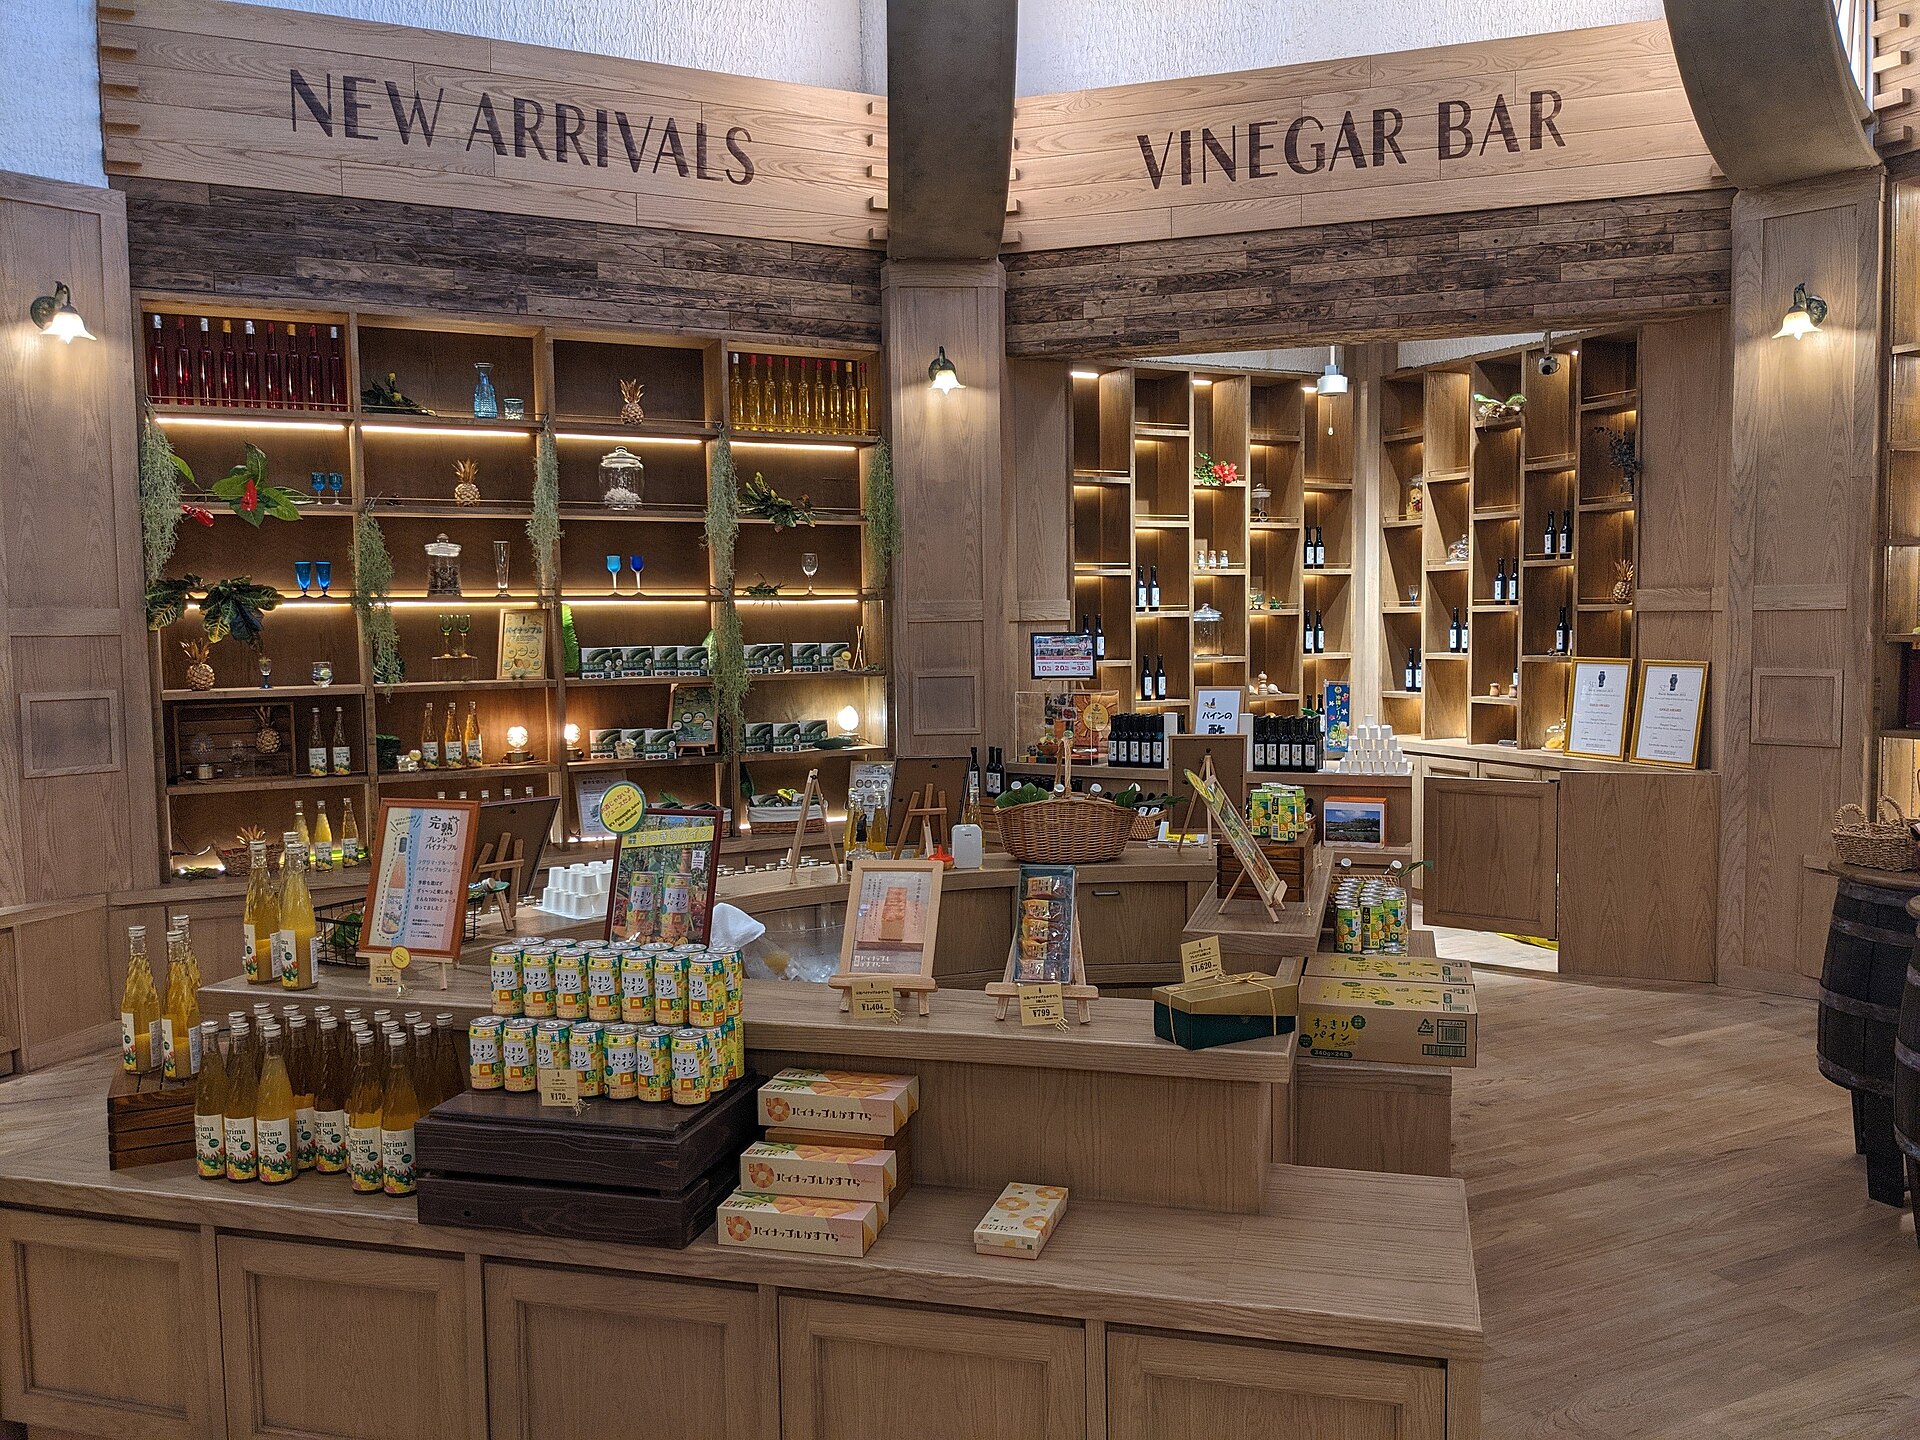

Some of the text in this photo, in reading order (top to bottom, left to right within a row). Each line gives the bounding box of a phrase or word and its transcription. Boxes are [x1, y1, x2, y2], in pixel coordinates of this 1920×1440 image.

[291, 69, 754, 186] NEW ARRIVALS
[1136, 89, 1567, 190] VINEGAR BAR
[1202, 712, 1233, 720] パインの
[428, 815, 454, 836] 完熟
[640, 829, 710, 843] すっきりパイン
[1190, 961, 1212, 973] ¥1,620
[861, 1003, 884, 1011] ¥1,404
[1032, 1009, 1050, 1017] ¥799
[1313, 1017, 1350, 1031] すっきり
[1313, 1031, 1350, 1042] パイン
[611, 1052, 634, 1060] すっきり
[791, 1107, 873, 1121] パイナップルかすてら
[322, 1127, 334, 1135] Sol
[232, 1135, 243, 1143] Sol
[267, 1137, 279, 1145] Sol
[393, 1147, 405, 1156] Sol
[776, 1173, 861, 1187] パイナップルかすてら
[753, 1226, 839, 1242] パイナップルかすてら
